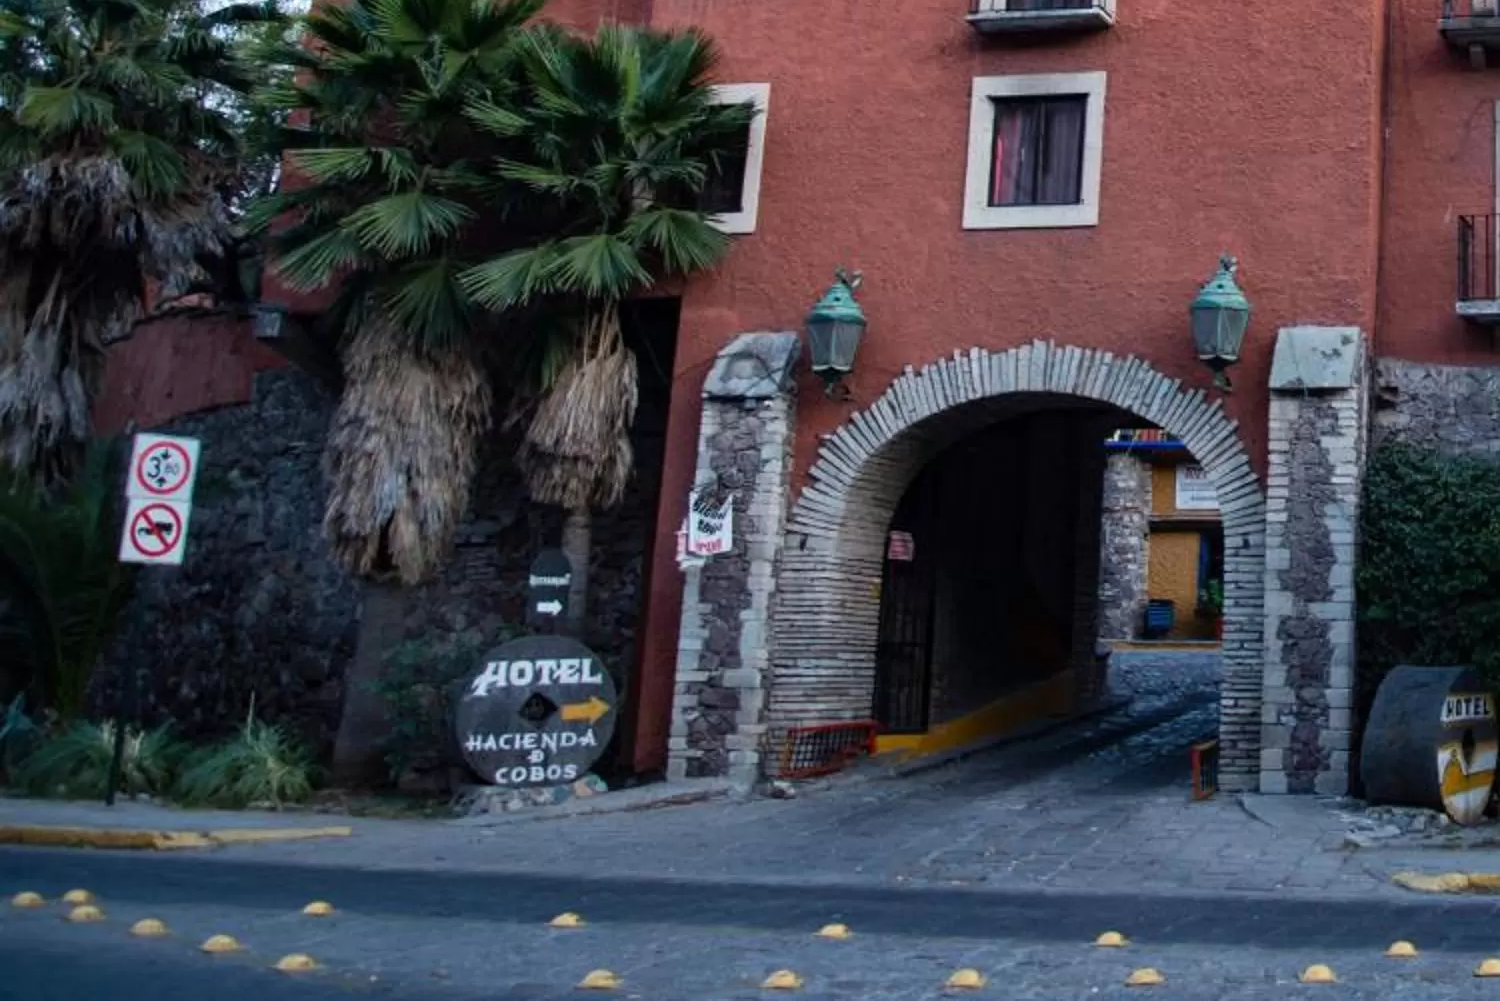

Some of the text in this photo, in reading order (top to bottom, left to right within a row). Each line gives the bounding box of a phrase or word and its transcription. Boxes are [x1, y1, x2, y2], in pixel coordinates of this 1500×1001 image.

[471, 658, 603, 697] HOTEL
[1446, 697, 1490, 720] HOTEL
[465, 728, 598, 753] HACIENDA
[495, 764, 578, 784] COBOS
